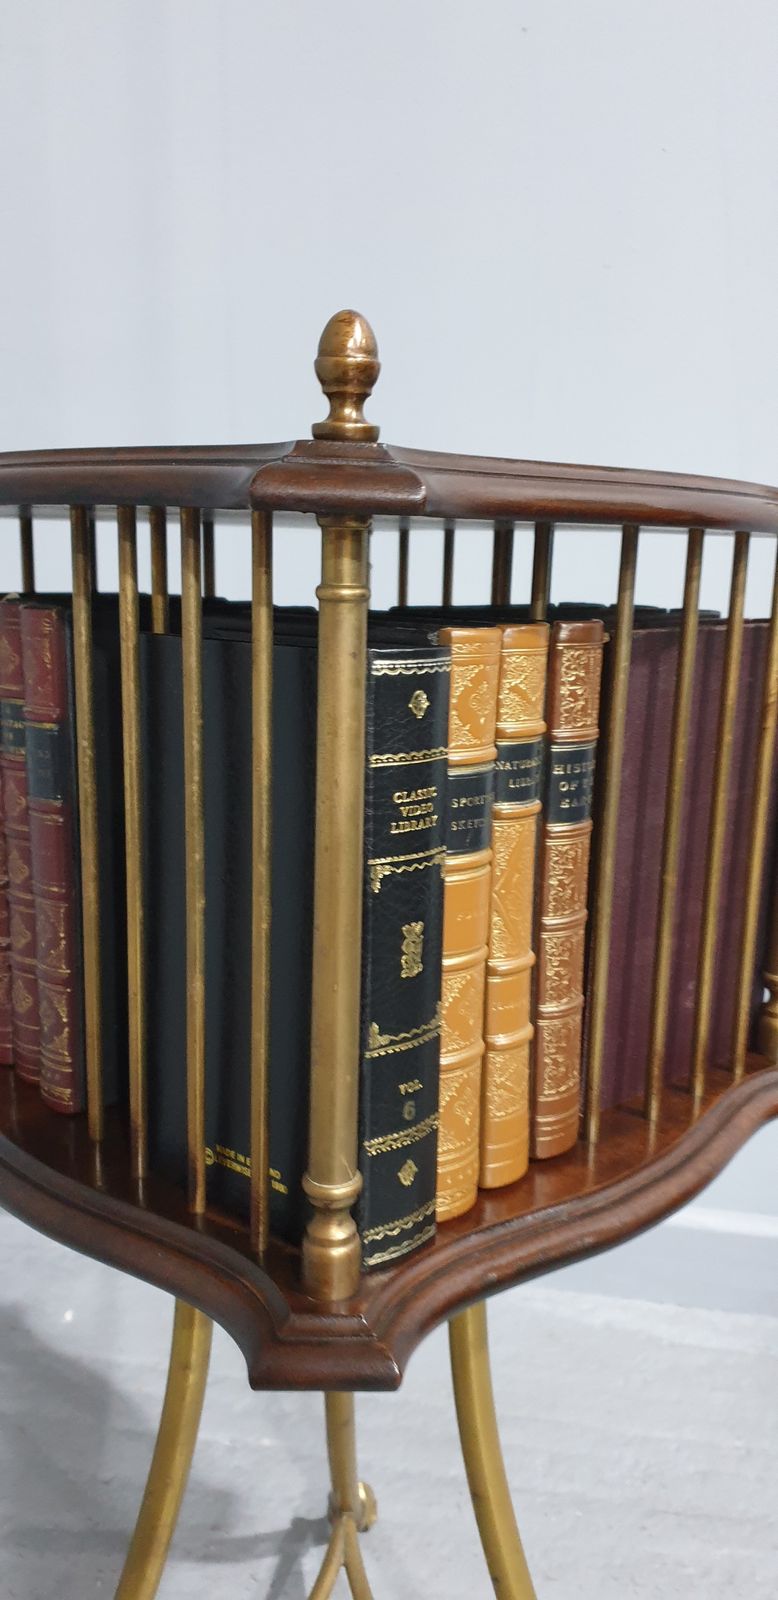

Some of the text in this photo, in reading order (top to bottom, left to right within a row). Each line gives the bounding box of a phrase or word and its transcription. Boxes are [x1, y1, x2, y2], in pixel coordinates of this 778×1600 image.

[494, 756, 542, 771] NATURA
[393, 786, 438, 804] CLASSIC
[399, 802, 434, 817] VIDEO
[390, 815, 438, 834] LIBRARY
[403, 1100, 416, 1121] 6
